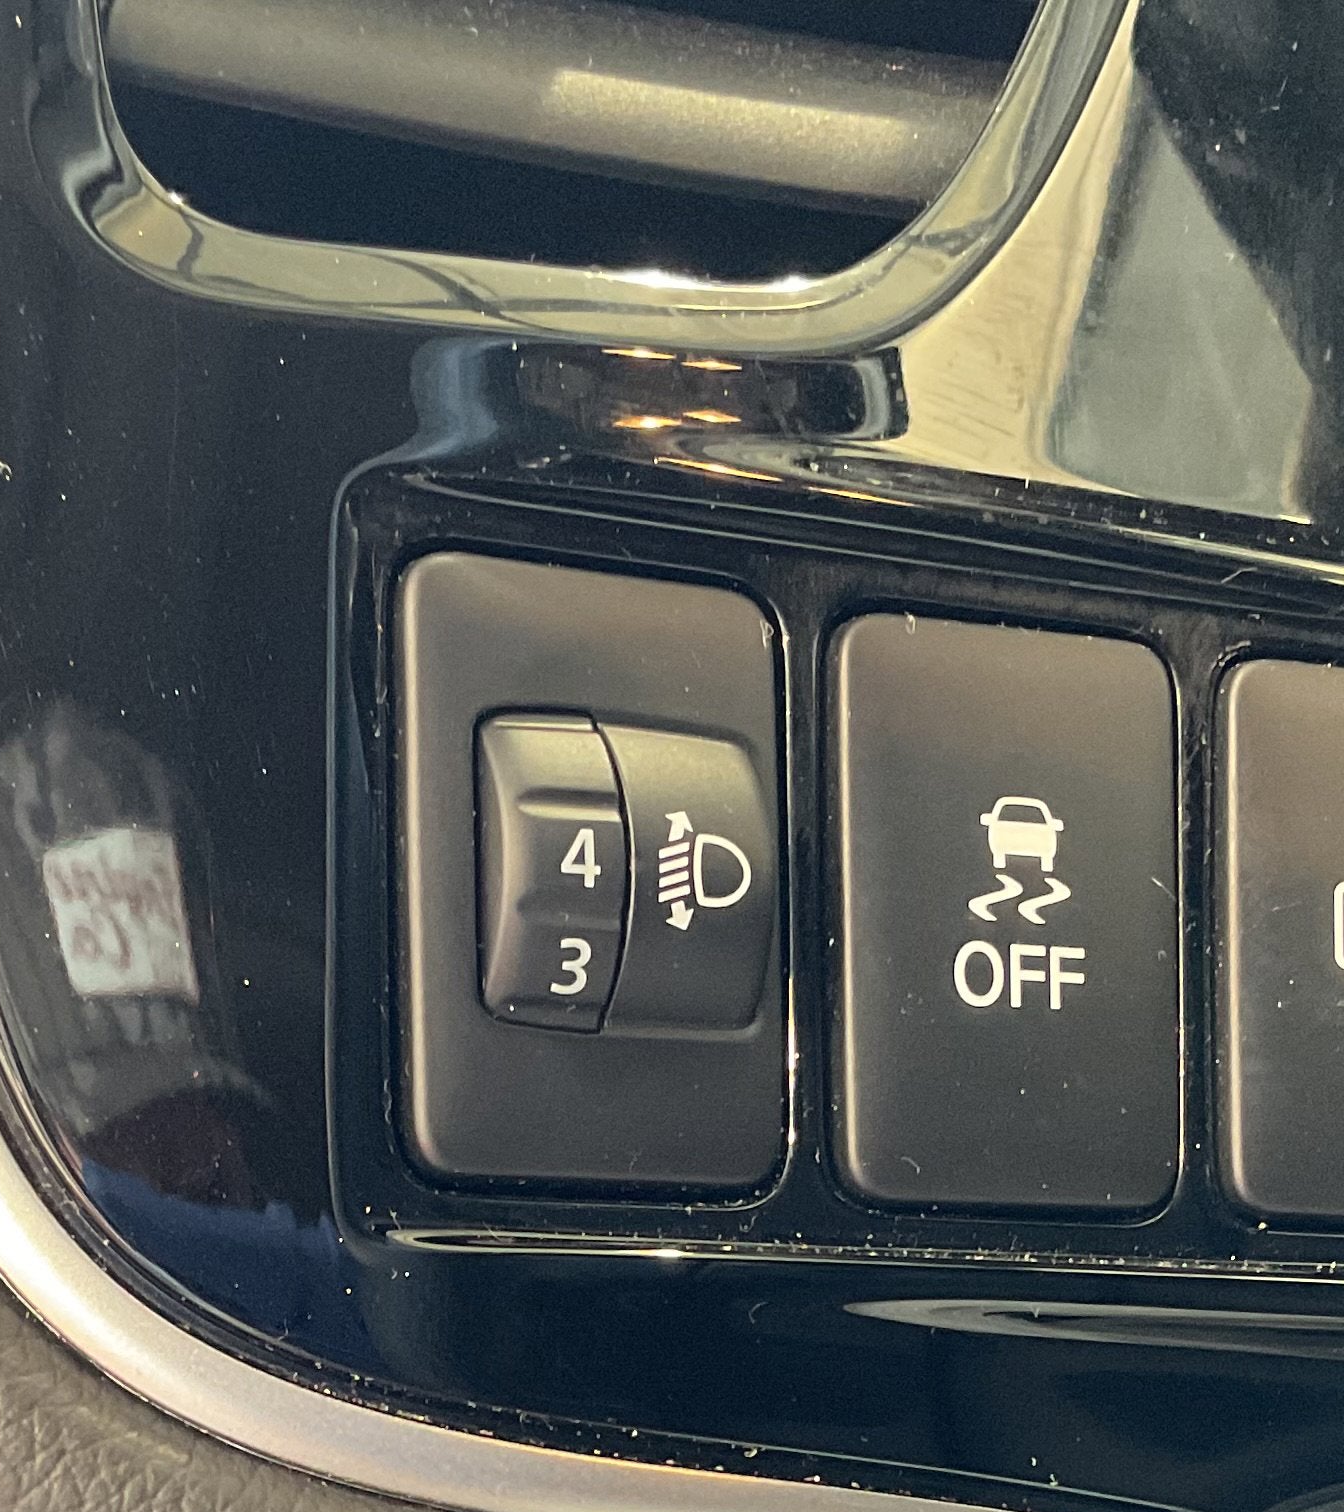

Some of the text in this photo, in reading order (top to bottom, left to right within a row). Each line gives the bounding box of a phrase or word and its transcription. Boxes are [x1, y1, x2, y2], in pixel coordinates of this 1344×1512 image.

[559, 828, 602, 889] 4
[549, 938, 592, 996] 3
[953, 940, 1086, 1010] OFF
